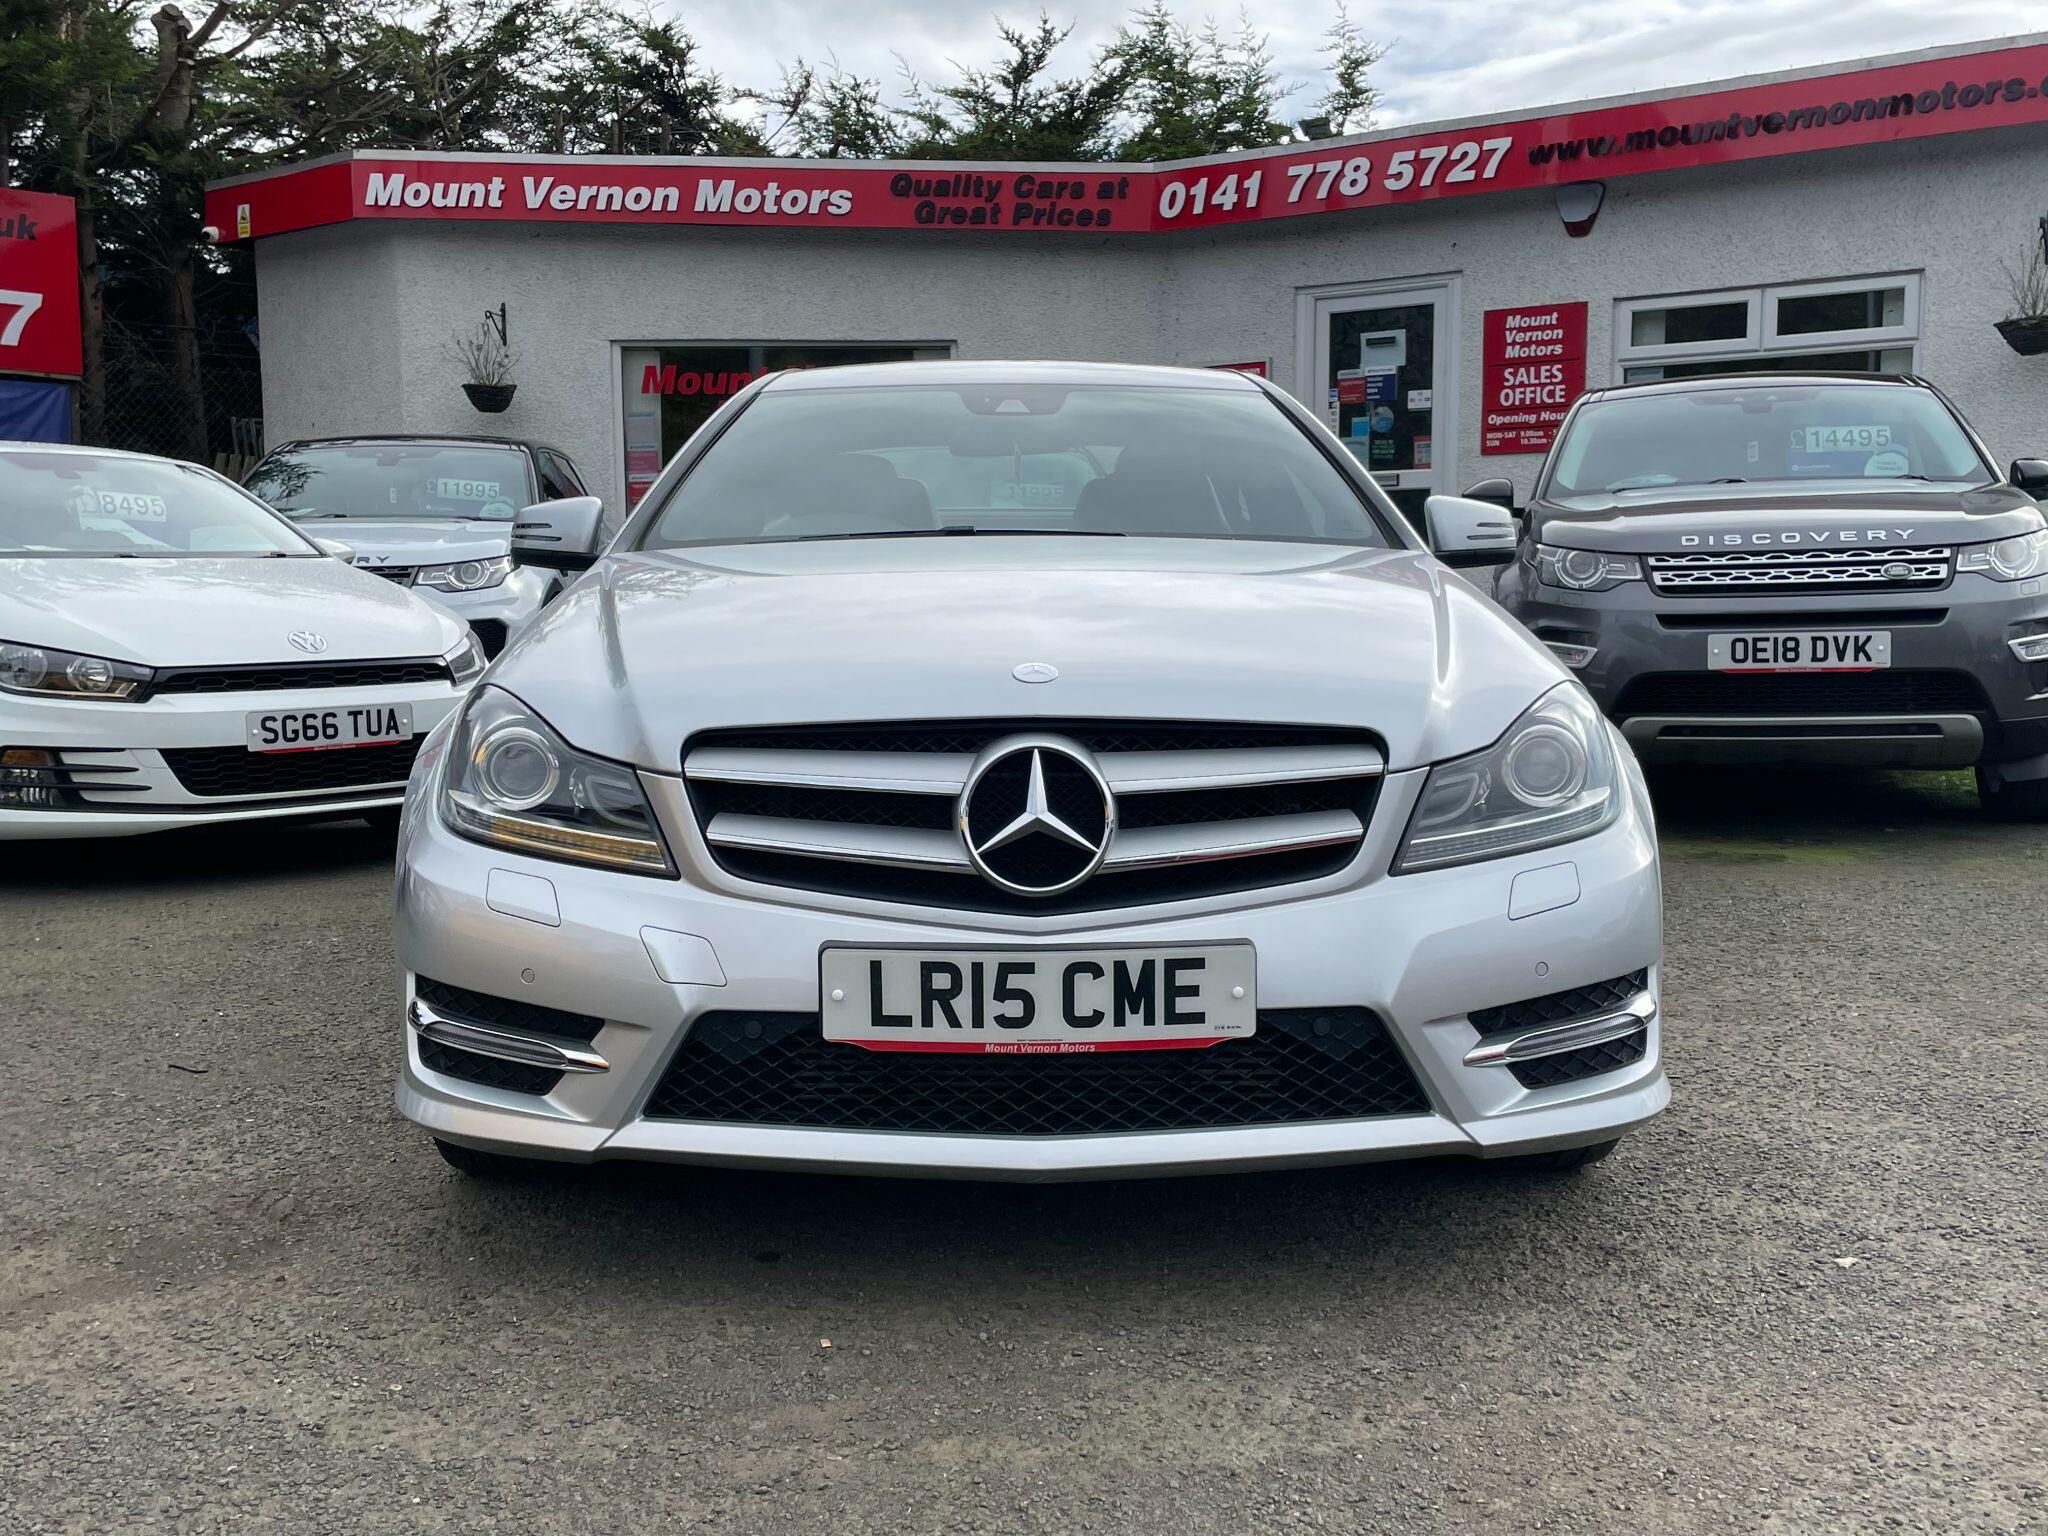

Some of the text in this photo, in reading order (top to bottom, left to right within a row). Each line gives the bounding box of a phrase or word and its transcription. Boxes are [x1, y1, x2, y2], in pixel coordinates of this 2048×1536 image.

[890, 173, 1130, 202] Quality Cars at
[1158, 136, 1513, 219] 0141 778 5727
[364, 172, 853, 215] Mount Vernon Motors
[913, 200, 1112, 227] Great Prices
[1505, 312, 1559, 329] Mount
[1505, 328, 1564, 344] Vernon
[1504, 344, 1564, 359] Motors
[1504, 364, 1563, 386] SALES
[1500, 385, 1566, 407] OFFICE
[1488, 411, 1567, 426] Opening Hou
[1486, 439, 1500, 447] SUN
[1681, 528, 1915, 546] DISCOVERY
[1730, 634, 1873, 664] OE18 DVK
[260, 708, 401, 744] SG66 TUA
[869, 957, 1206, 1029] LR15 CME
[984, 1042, 1096, 1053] Mount Vernon Motors
